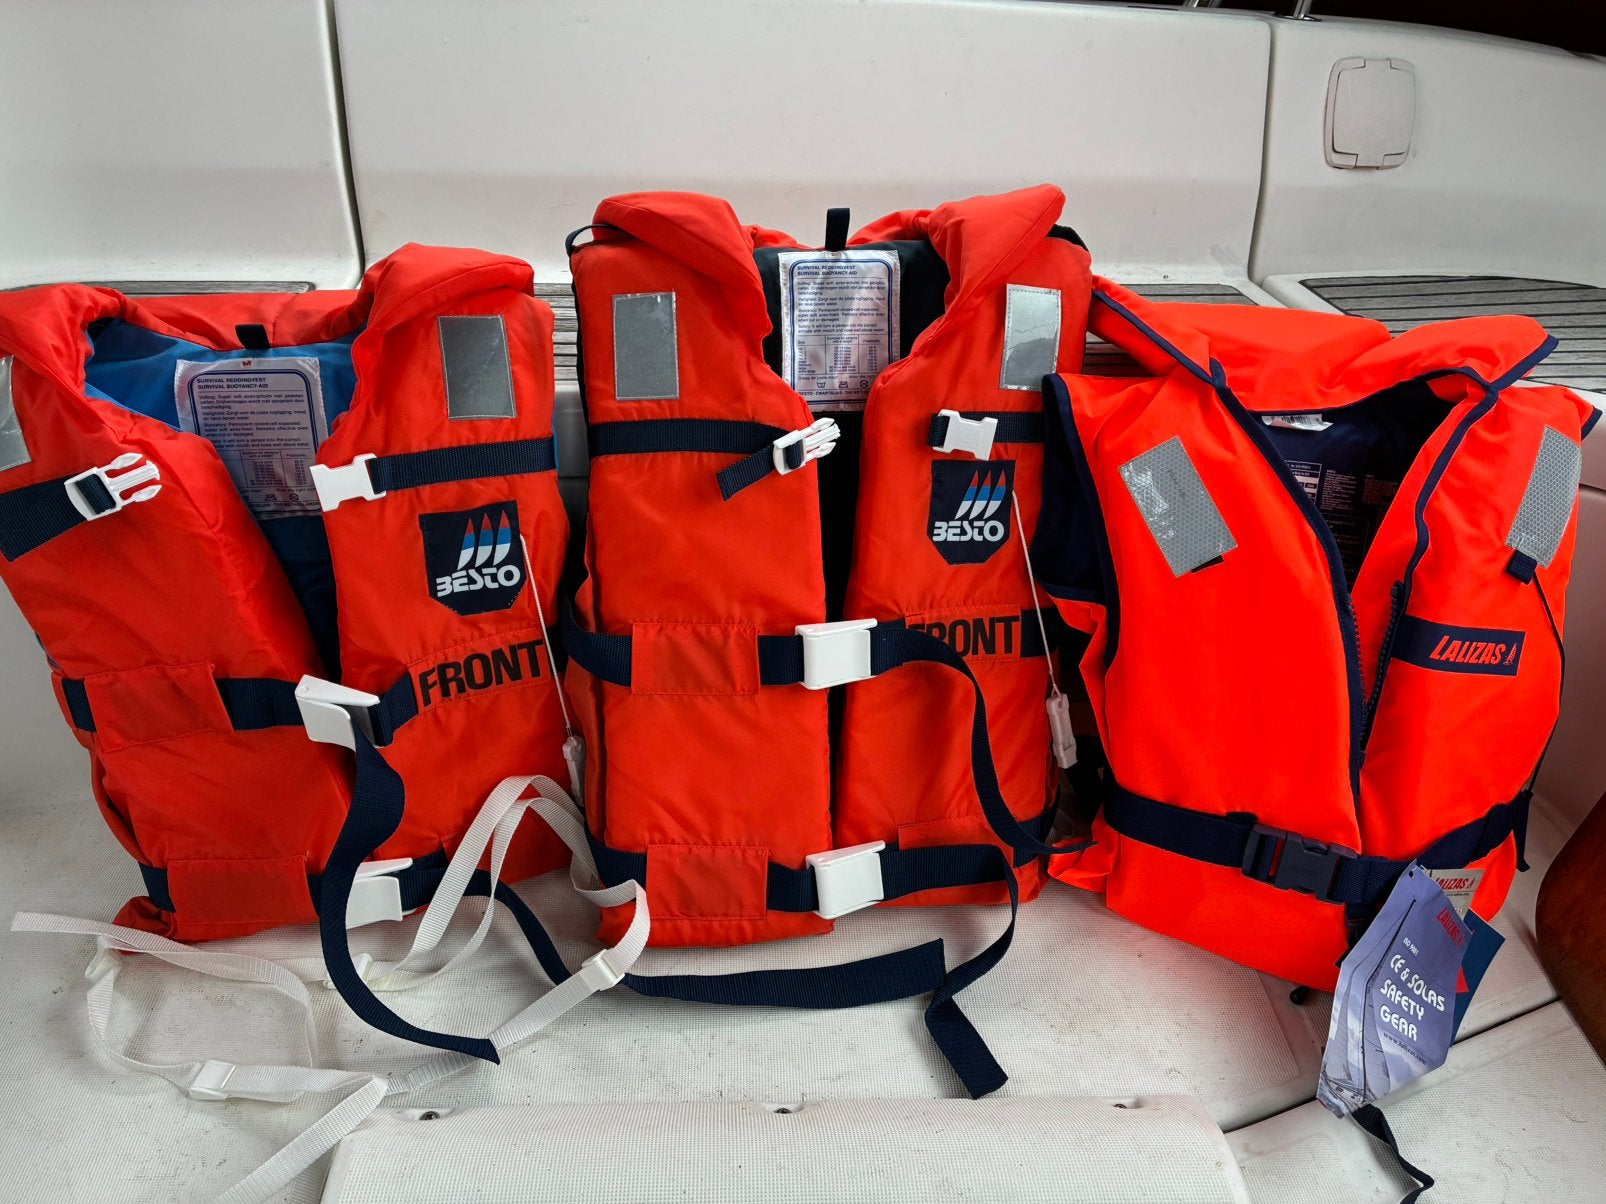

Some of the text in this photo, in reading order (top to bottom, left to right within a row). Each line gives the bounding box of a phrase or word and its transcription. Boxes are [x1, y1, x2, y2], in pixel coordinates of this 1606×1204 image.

[932, 520, 1005, 542] BESTO
[436, 564, 521, 597] BESTO
[908, 615, 1020, 657] RONT
[1429, 635, 1507, 665] LALIZAS
[418, 639, 544, 707] FRONT
[1380, 979, 1424, 1021] SAFETY
[1390, 954, 1445, 1012] CE & SOLAS
[1380, 1005, 1418, 1042] GEAR
